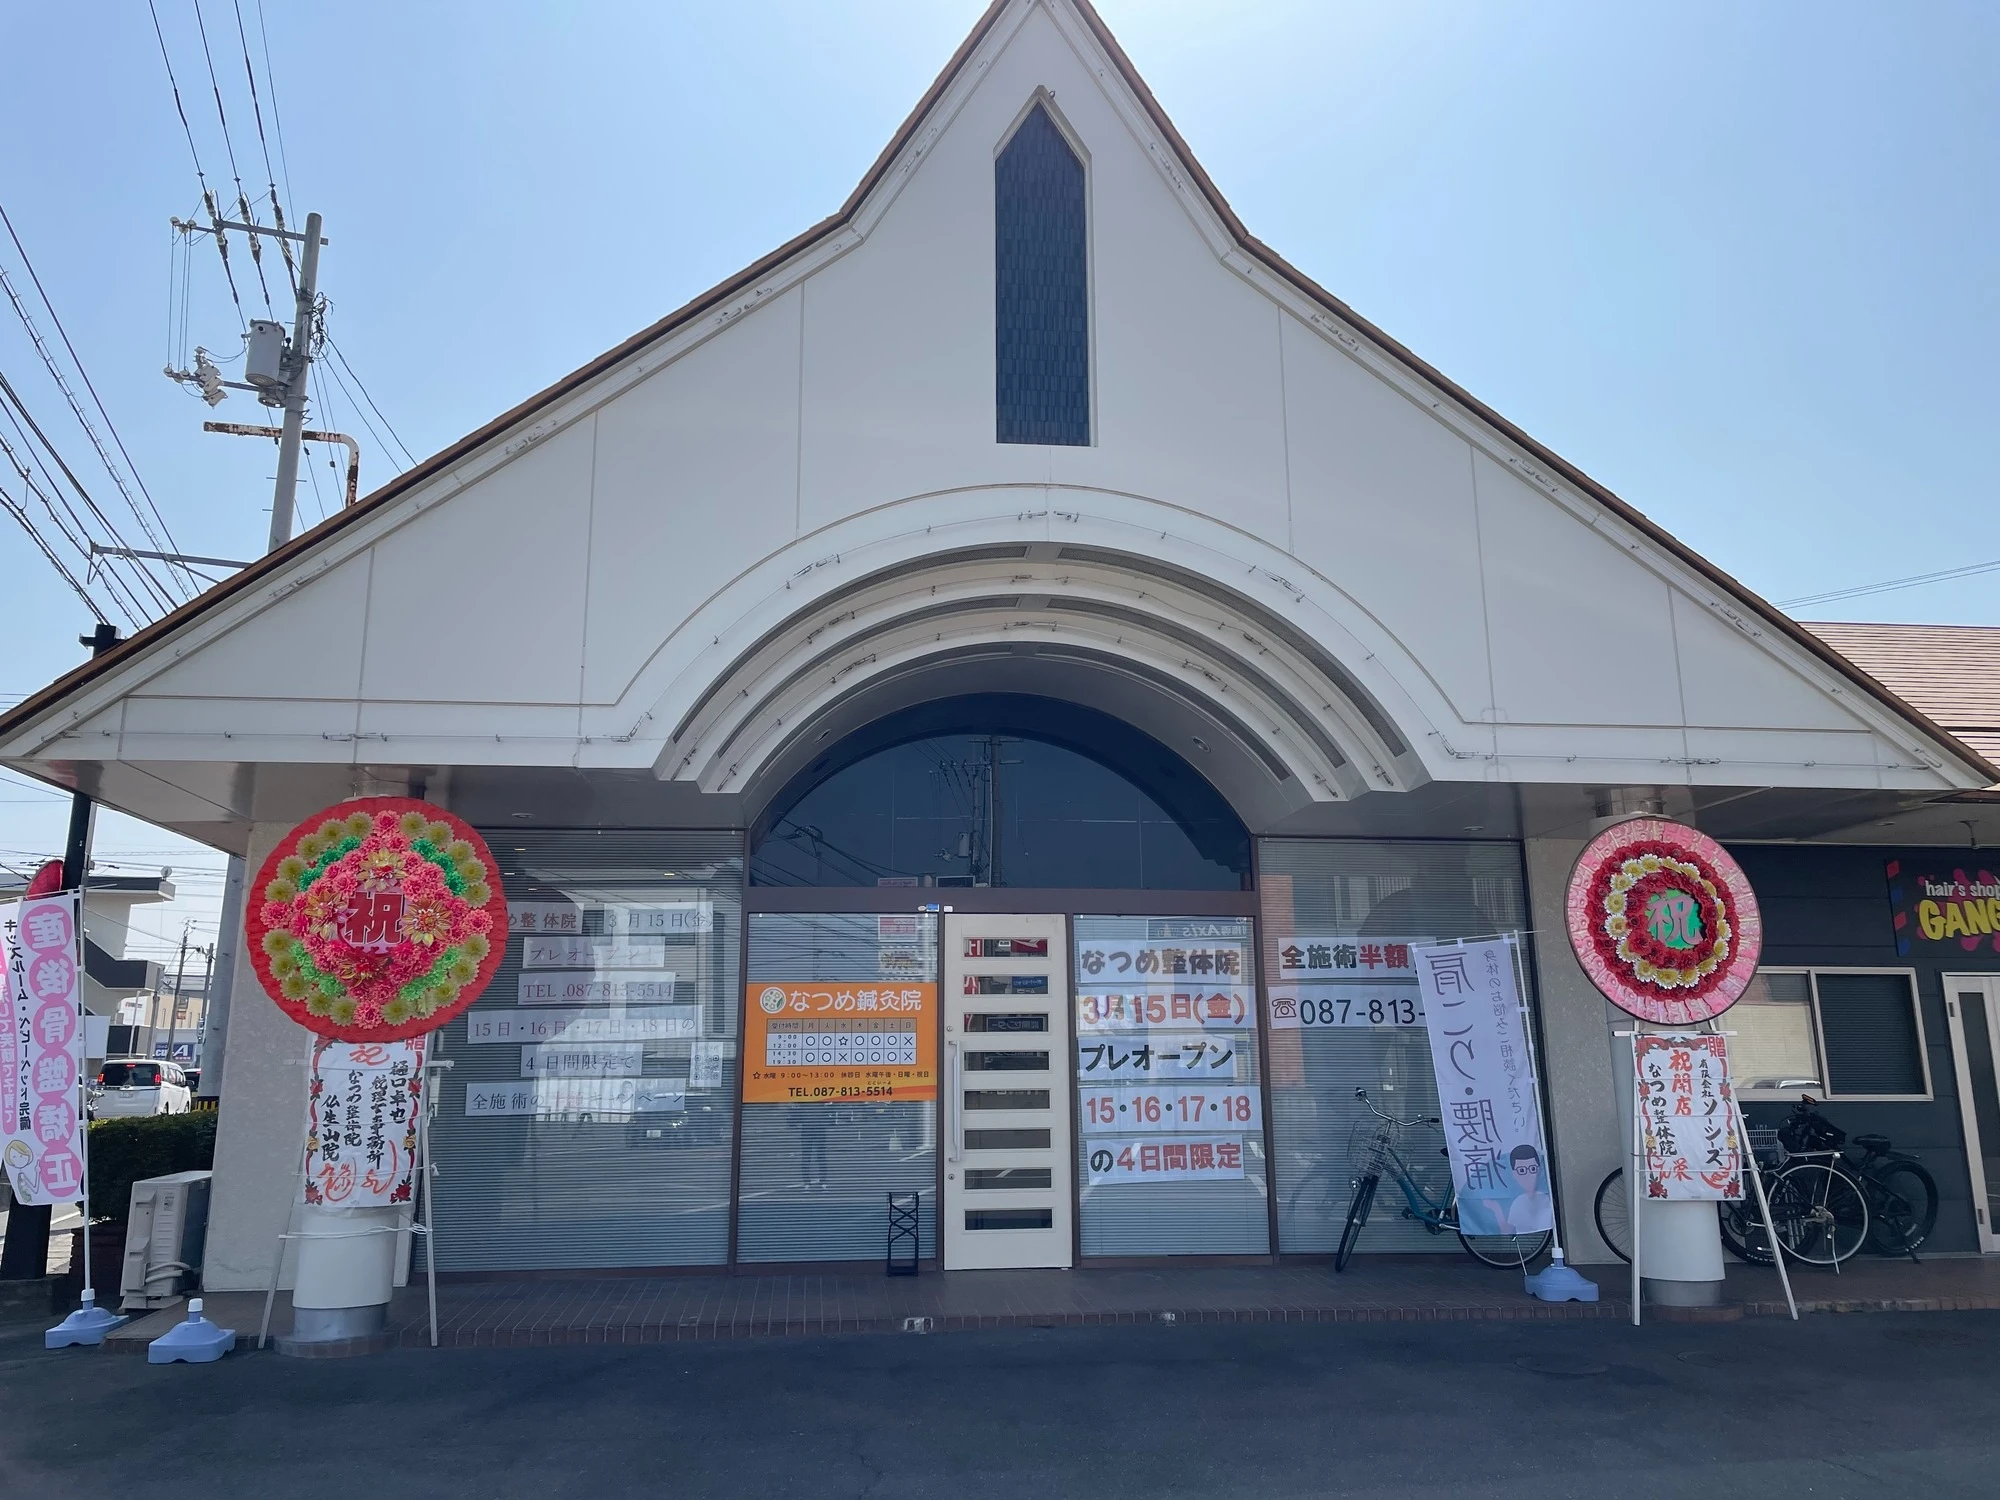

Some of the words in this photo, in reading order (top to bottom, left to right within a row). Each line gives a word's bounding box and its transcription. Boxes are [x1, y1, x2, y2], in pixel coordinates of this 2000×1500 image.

[1925, 880, 1966, 897] hair's
[1970, 881, 2000, 900] shop
[345, 891, 403, 945] 祝
[1648, 893, 1700, 947] 祝
[1081, 948, 1240, 975] なつめ整体院
[1281, 943, 1417, 970] 全施術半額
[789, 990, 922, 1012] なつめ鍼灸院
[1083, 992, 1245, 1025] 3月15日(金)
[1299, 998, 1426, 1025] 087-813-
[1081, 1041, 1233, 1071] プレオープン
[1707, 1036, 1727, 1058] 贈
[525, 1053, 636, 1071] 4日間限定で
[788, 1086, 893, 1098] TEL.087-813-5514
[1668, 1050, 1693, 1116] 祝開店
[1648, 1062, 1678, 1156] なつめ整体院
[321, 1094, 341, 1162] 仏生山院
[1090, 1142, 1242, 1173] の4日間限定
